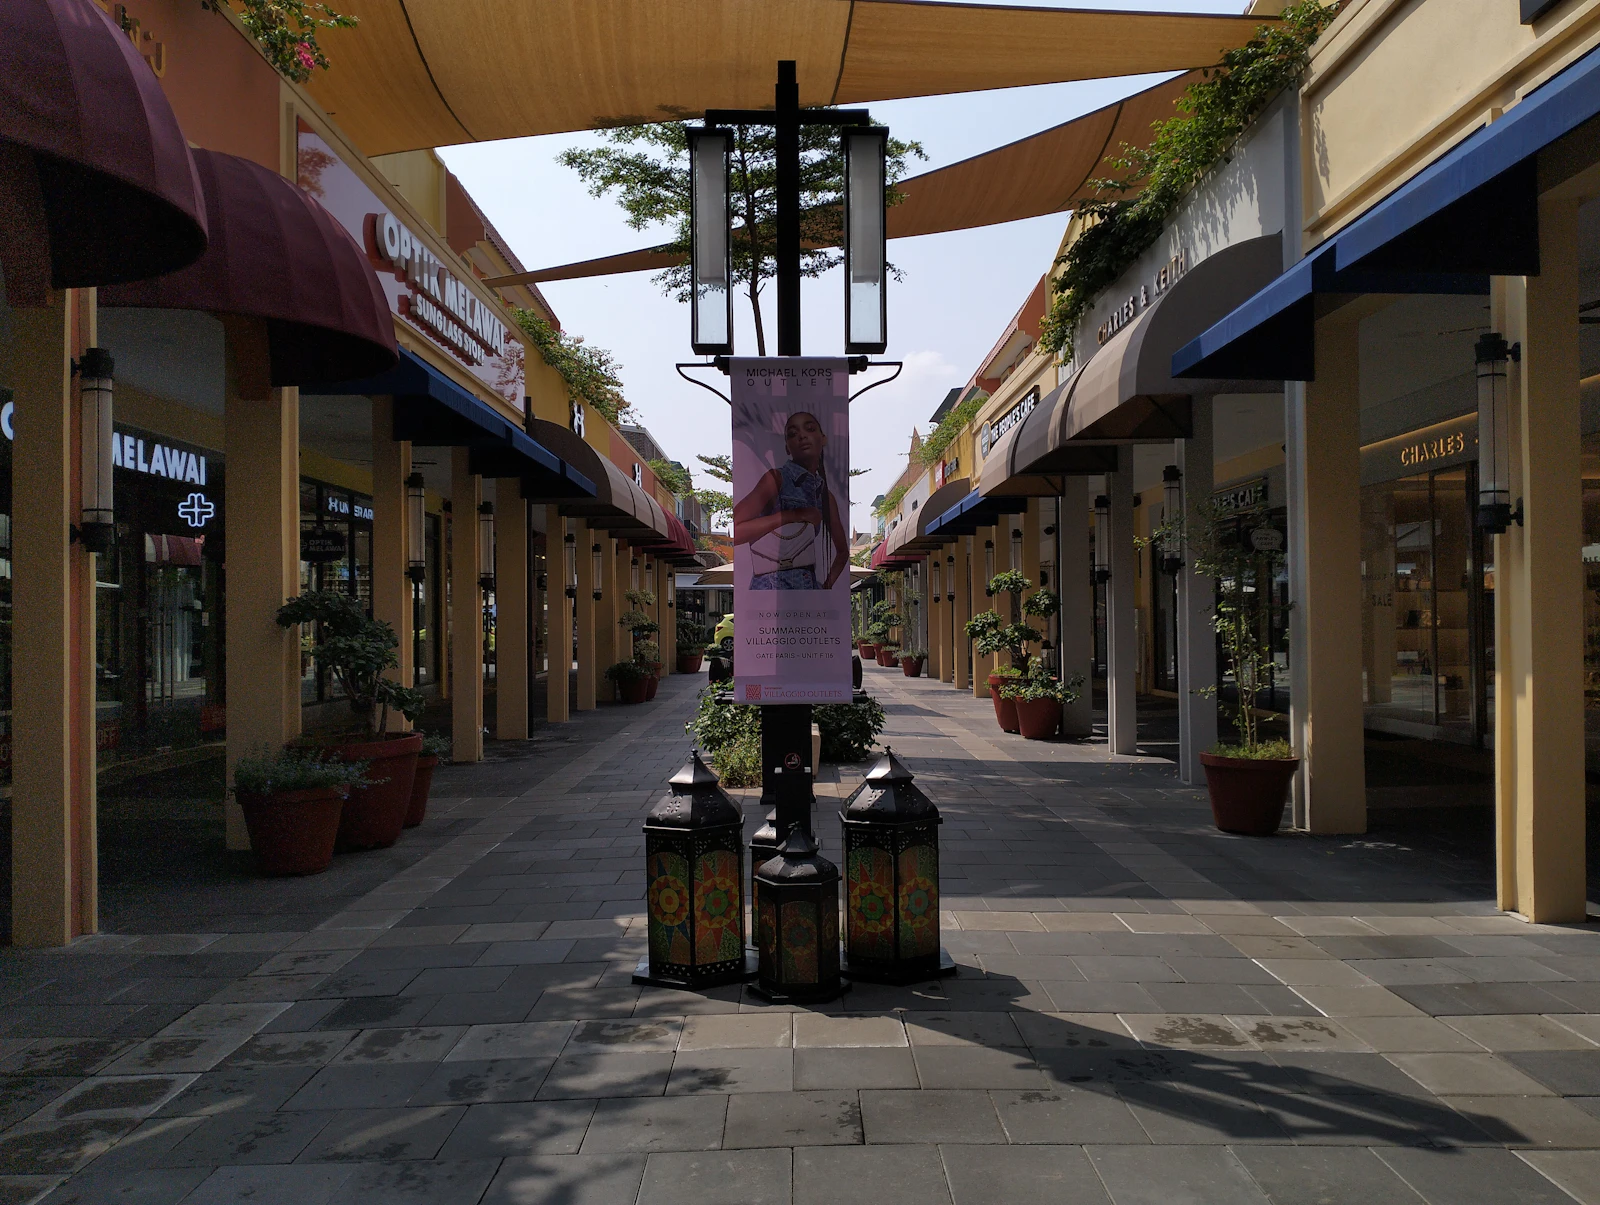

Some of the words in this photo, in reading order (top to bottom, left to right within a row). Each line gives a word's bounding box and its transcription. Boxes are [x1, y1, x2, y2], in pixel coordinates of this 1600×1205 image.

[379, 212, 442, 302] OPTIK
[444, 276, 506, 357] MELAWAI
[1098, 295, 1135, 345] CHARLES
[1141, 285, 1148, 308] &
[1154, 248, 1187, 297] KEITH
[415, 293, 463, 349] SUNGLASS
[463, 335, 485, 366] STORE
[746, 368, 797, 377] MICHAEL
[801, 368, 832, 377] KORS
[746, 378, 833, 387] OUTLET
[1020, 392, 1035, 418] CAFE
[1401, 431, 1464, 466] CHARLES
[1371, 594, 1392, 606] SALE
[758, 626, 827, 635] SUMMARECON
[745, 637, 797, 645] VILLAGGIO
[799, 637, 841, 645] OUTLETS
[764, 690, 806, 698] VILLAGGIO
[807, 690, 843, 698] OUTLETS
